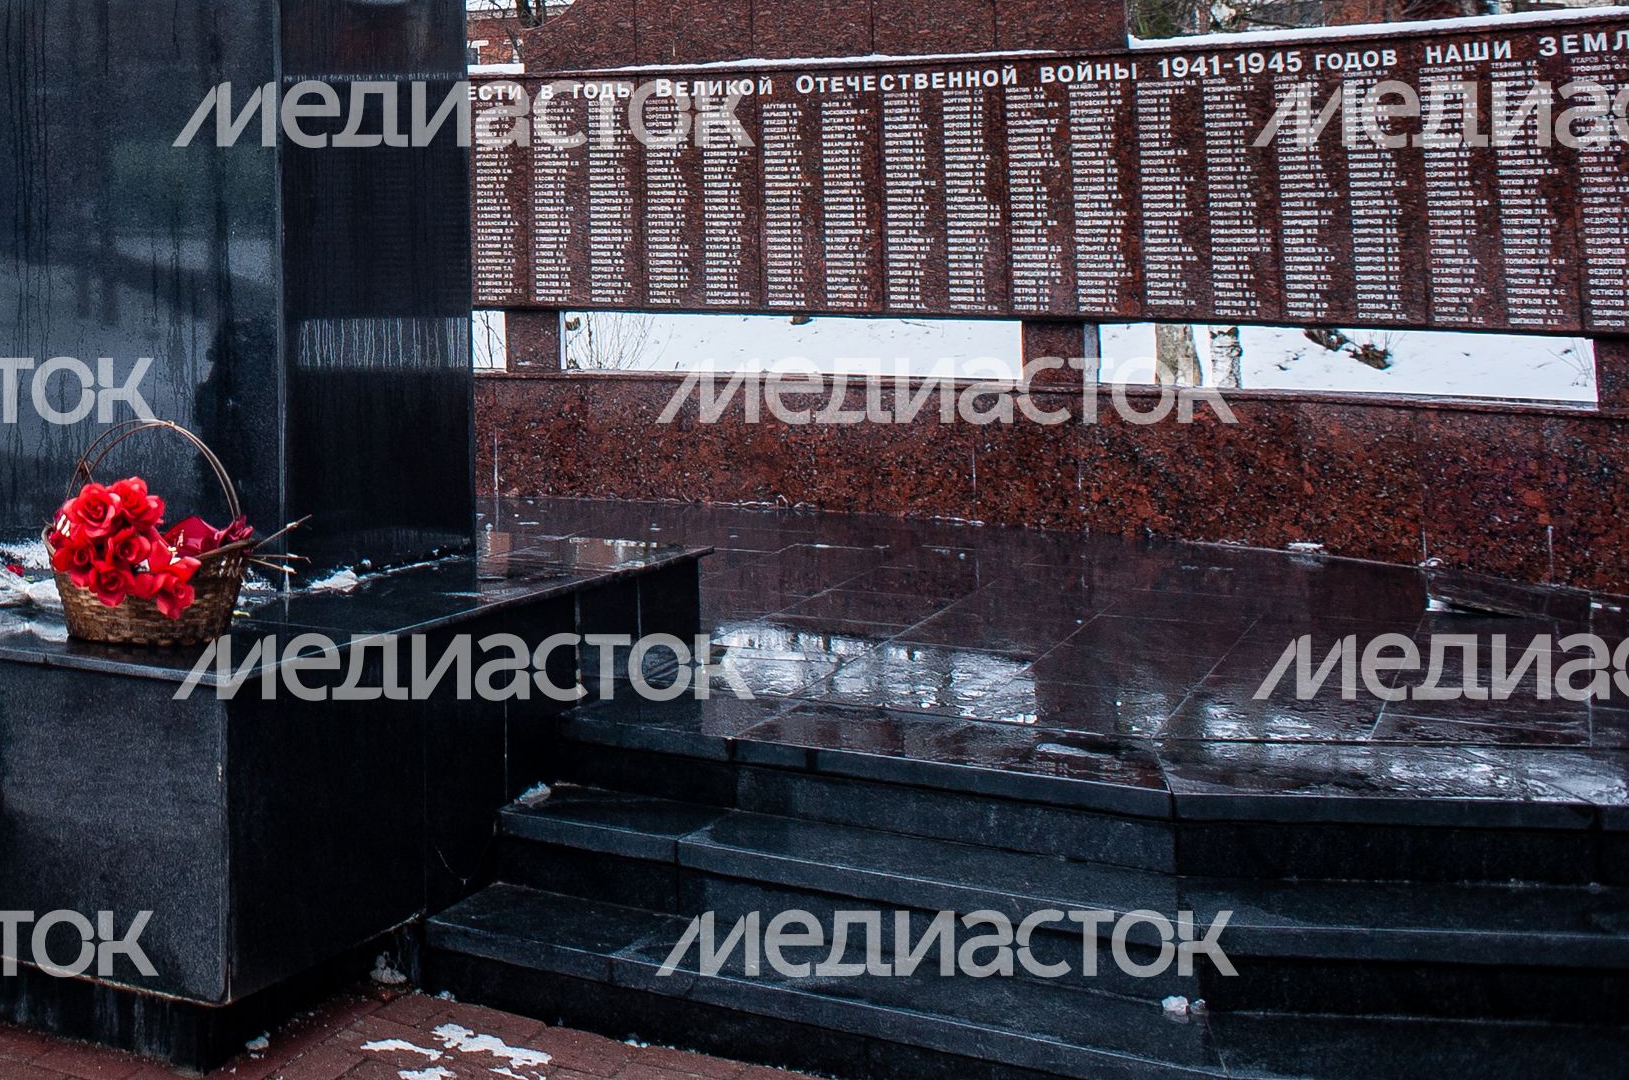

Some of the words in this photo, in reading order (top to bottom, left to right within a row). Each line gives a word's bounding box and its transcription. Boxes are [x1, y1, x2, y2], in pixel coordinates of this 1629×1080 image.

[541, 85, 554, 99] В
[796, 65, 1017, 94] ОТЕЧЕСТВЕННОЙ
[1040, 59, 1137, 83] ВОЙНЫ
[1157, 50, 1303, 79] 1941-1945
[1315, 49, 1397, 72] ГОДОВ
[1426, 40, 1512, 65] НАШИ
